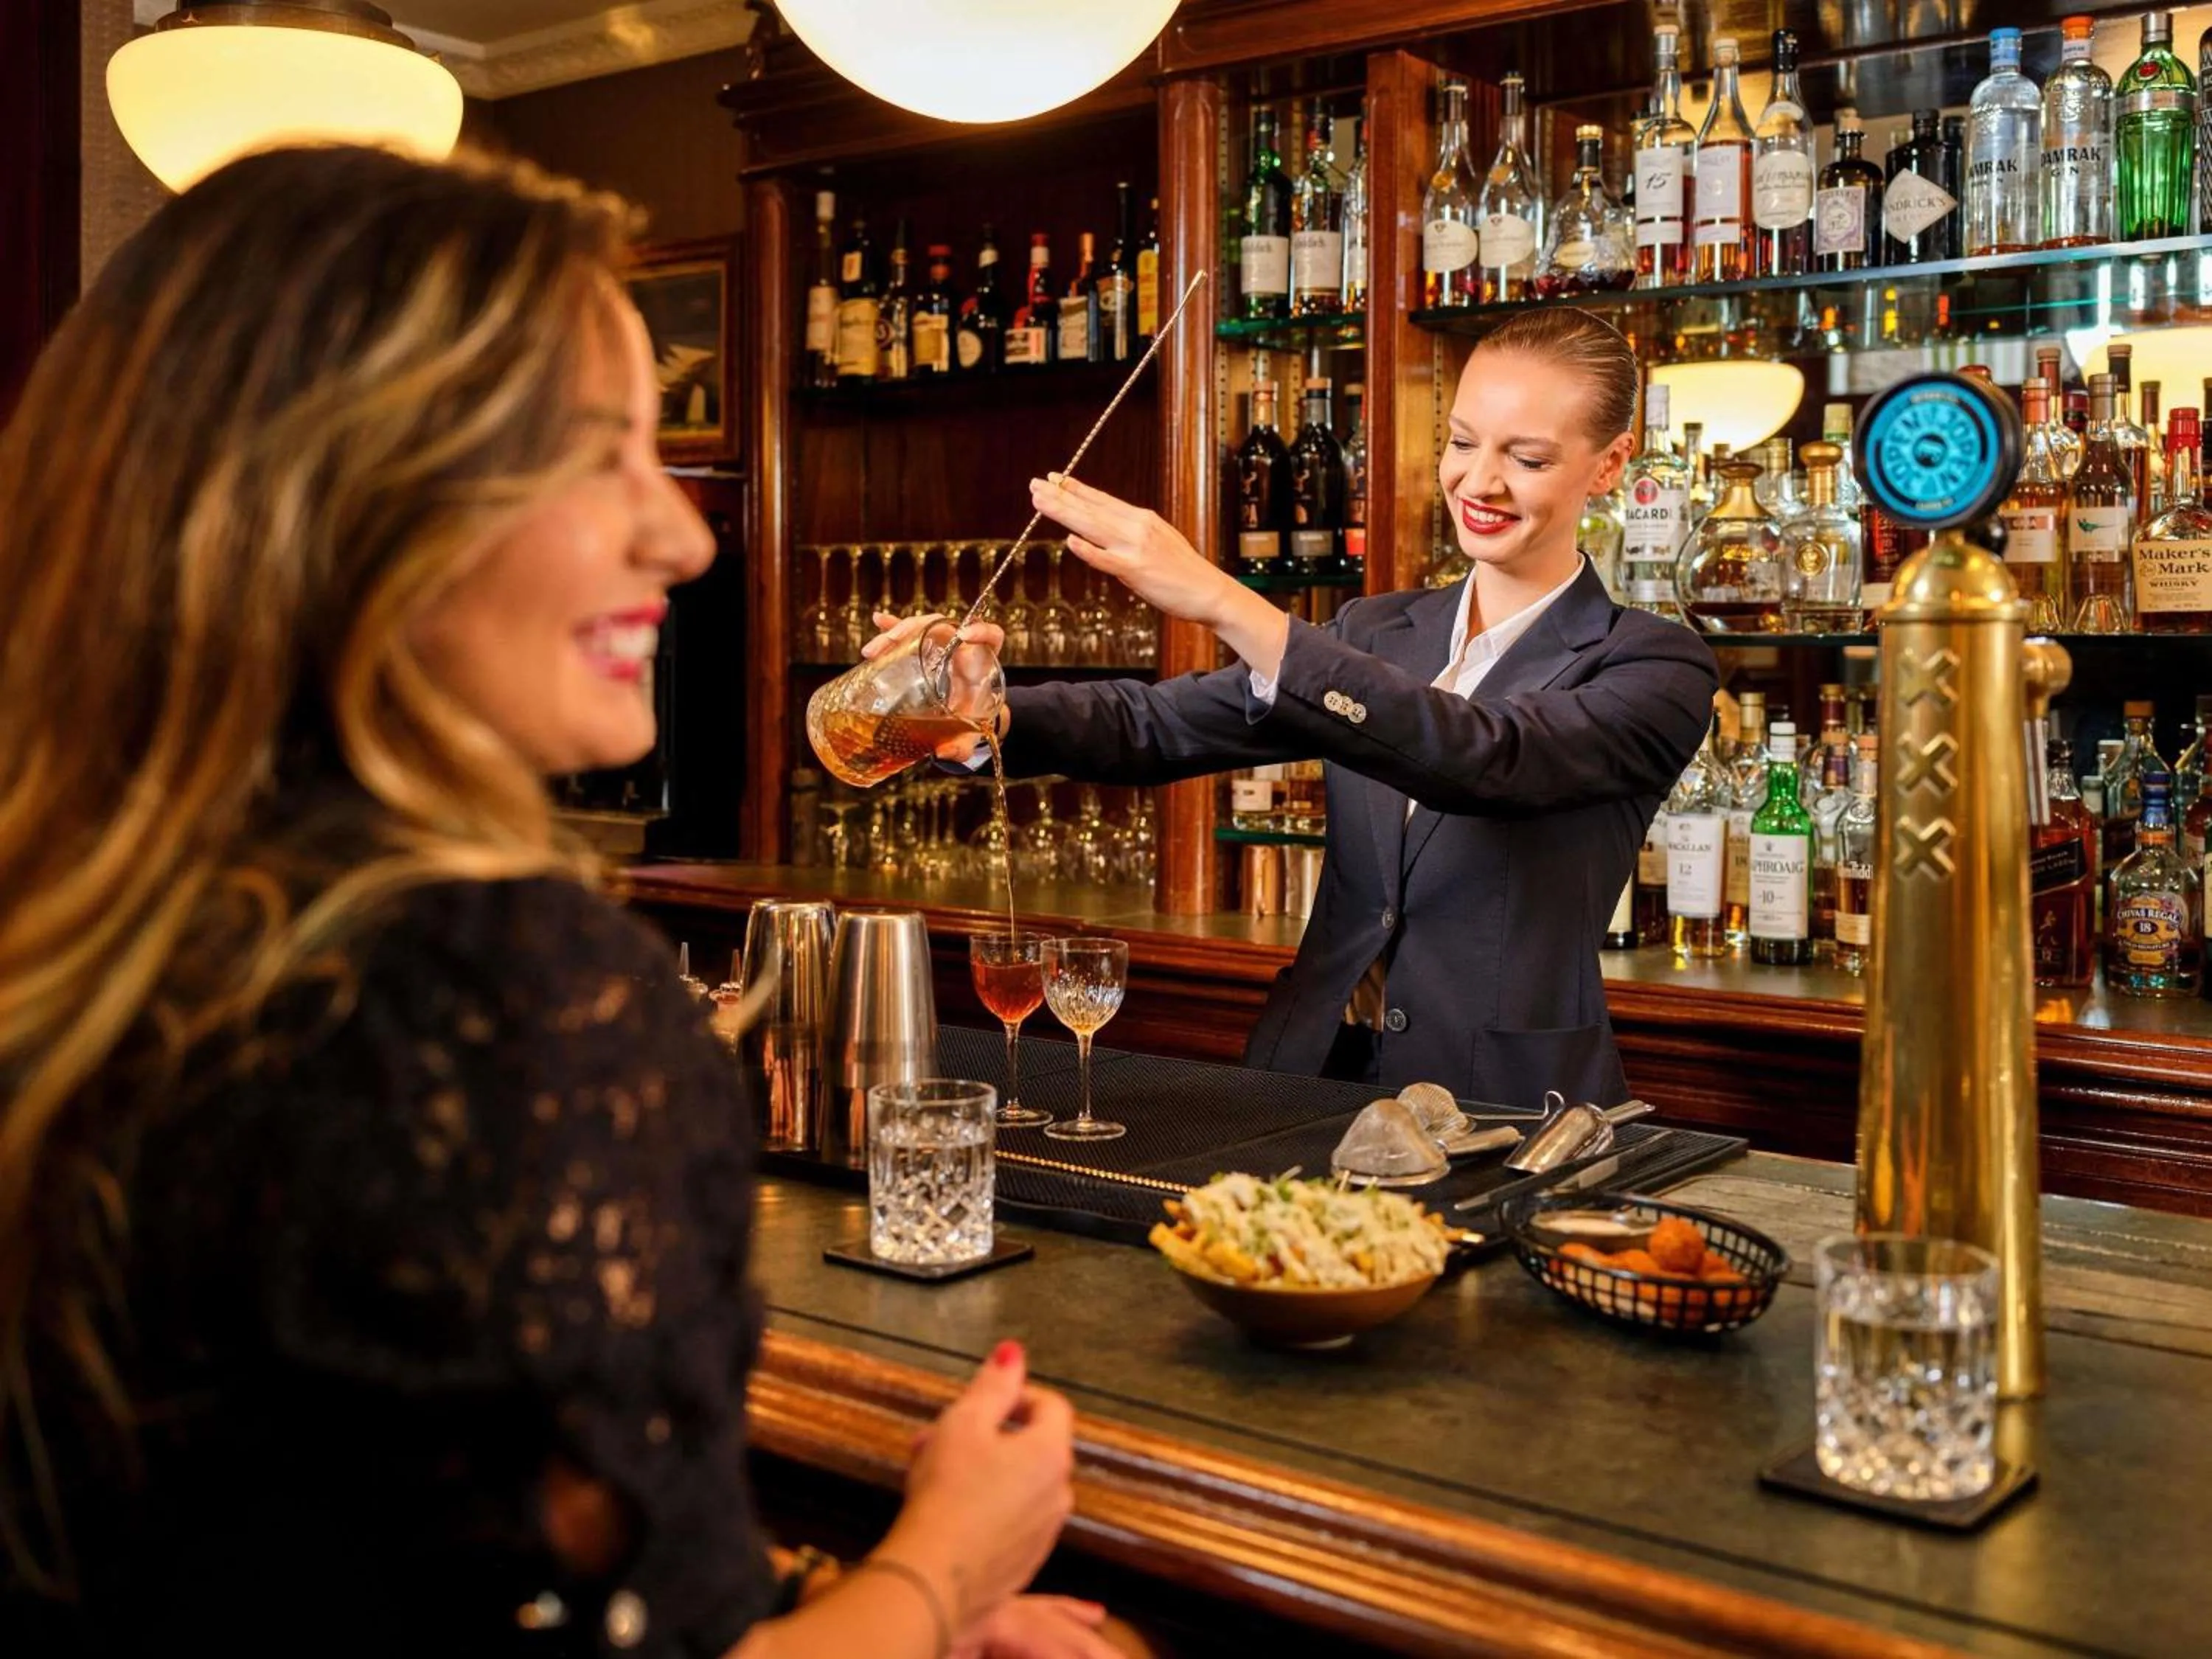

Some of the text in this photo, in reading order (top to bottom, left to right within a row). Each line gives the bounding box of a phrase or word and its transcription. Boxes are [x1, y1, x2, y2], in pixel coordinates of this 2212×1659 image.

[1969, 159, 2018, 178] AMRAK
[2051, 166, 2079, 178] GN
[1645, 172, 1672, 189] 15
[2139, 548, 2211, 560] Maker's
[2158, 562, 2209, 574] Mark
[1680, 863, 1691, 876] 12
[1751, 860, 1804, 874] PHROAIG
[2148, 908, 2179, 922] REGAL
[2139, 922, 2152, 933] 18
